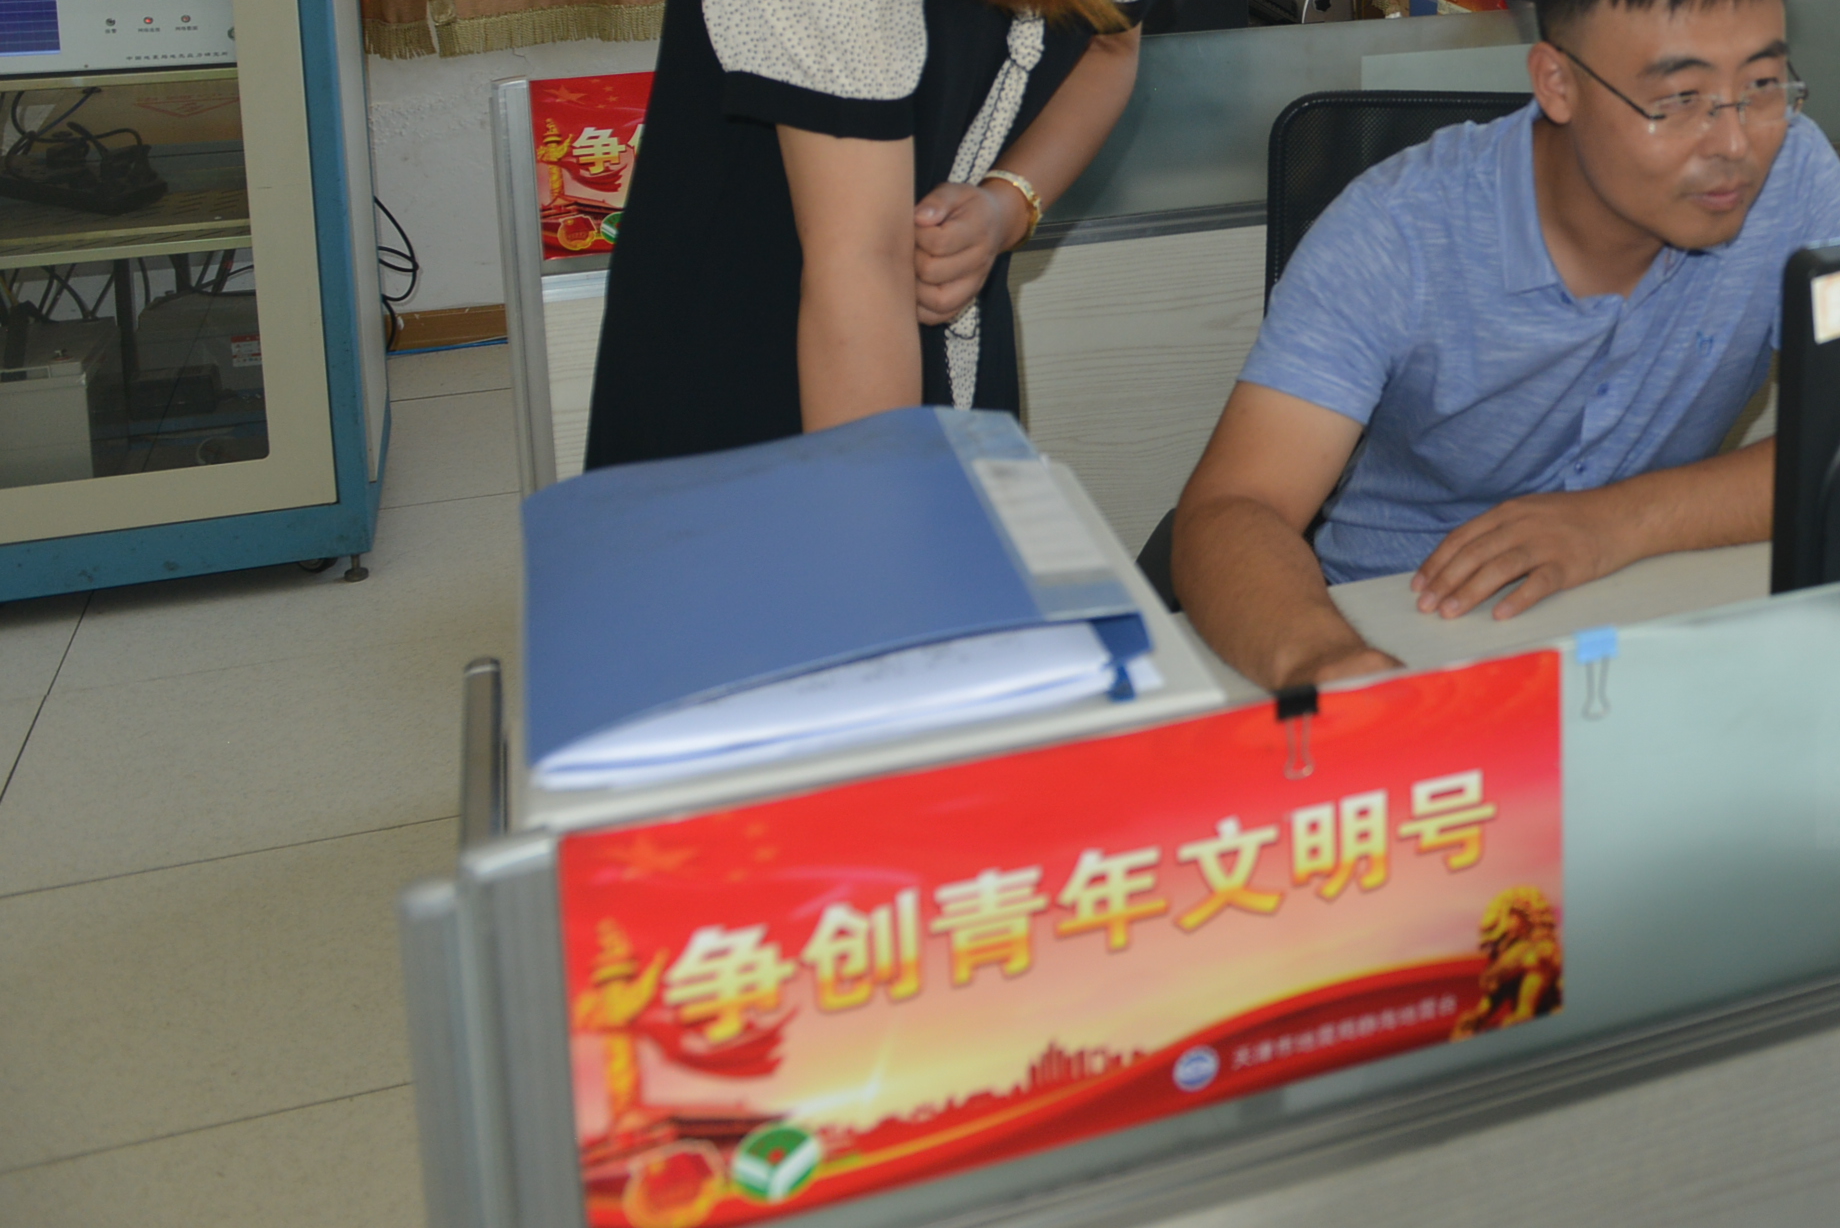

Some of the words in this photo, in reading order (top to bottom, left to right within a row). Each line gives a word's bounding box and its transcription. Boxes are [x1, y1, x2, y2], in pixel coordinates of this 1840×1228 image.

[664, 769, 1497, 1043] 争创青年文明号
